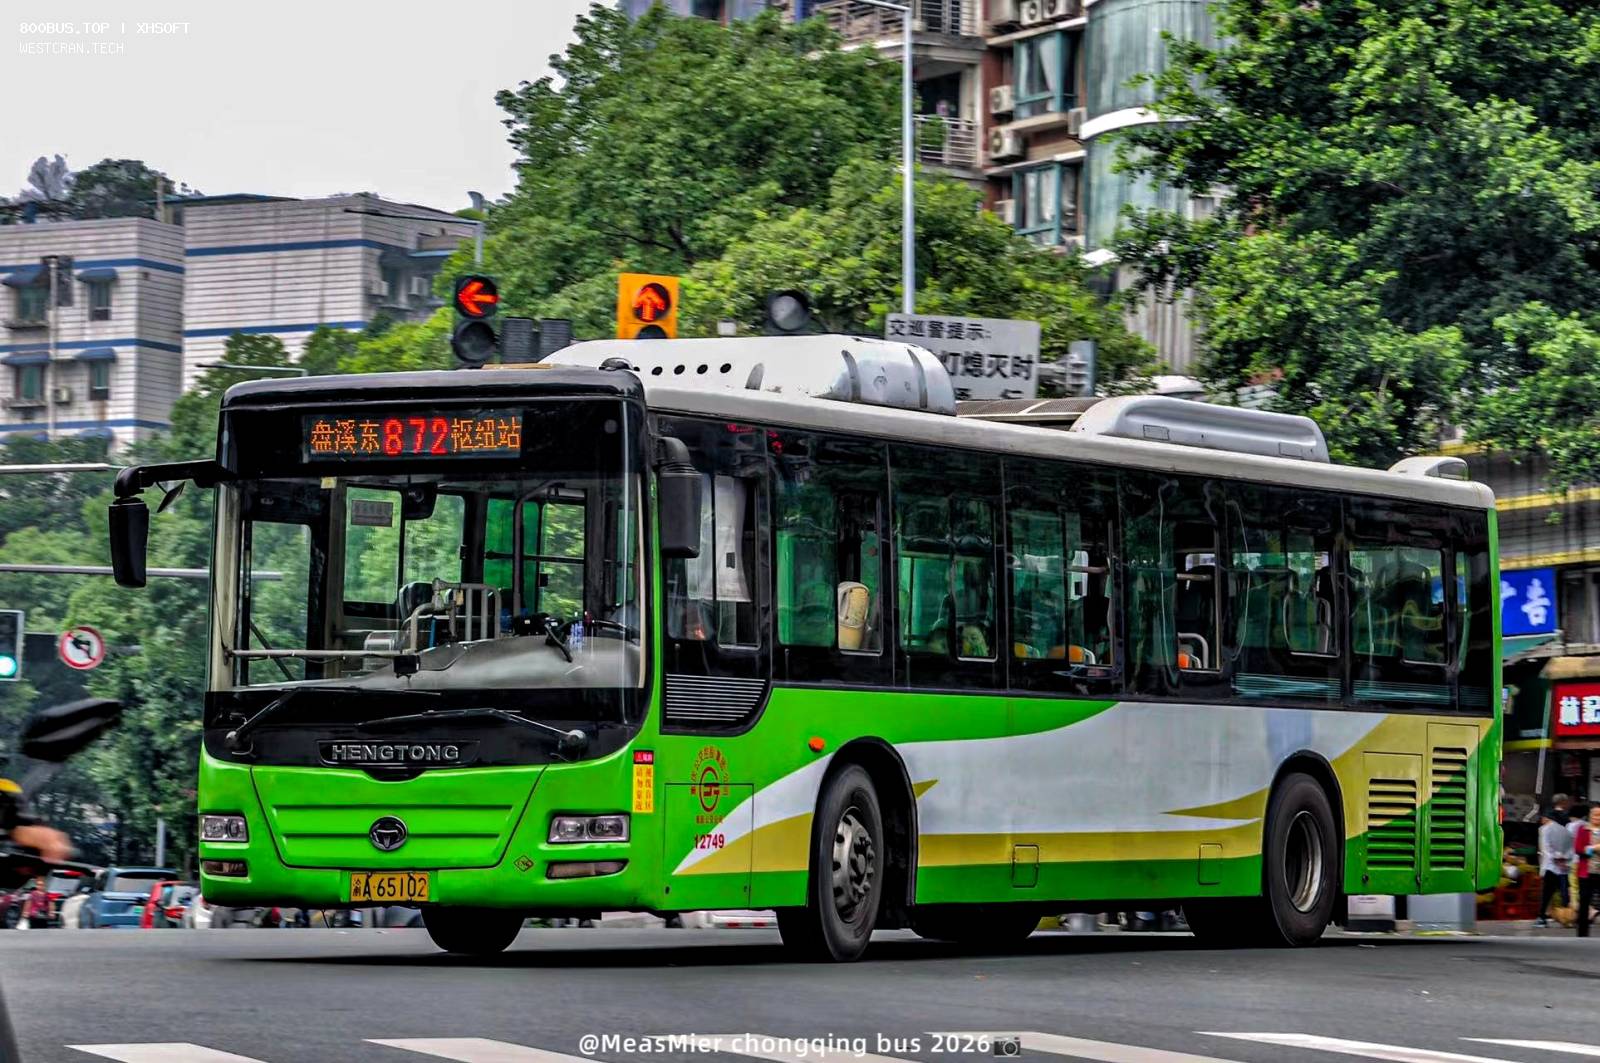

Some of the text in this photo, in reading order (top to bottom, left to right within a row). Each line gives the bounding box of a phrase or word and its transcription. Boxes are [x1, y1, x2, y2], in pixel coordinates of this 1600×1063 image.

[311, 416, 521, 457] 盘溪东 872 枢纽站
[331, 744, 459, 761] HENGTONG
[695, 833, 725, 850] 12749
